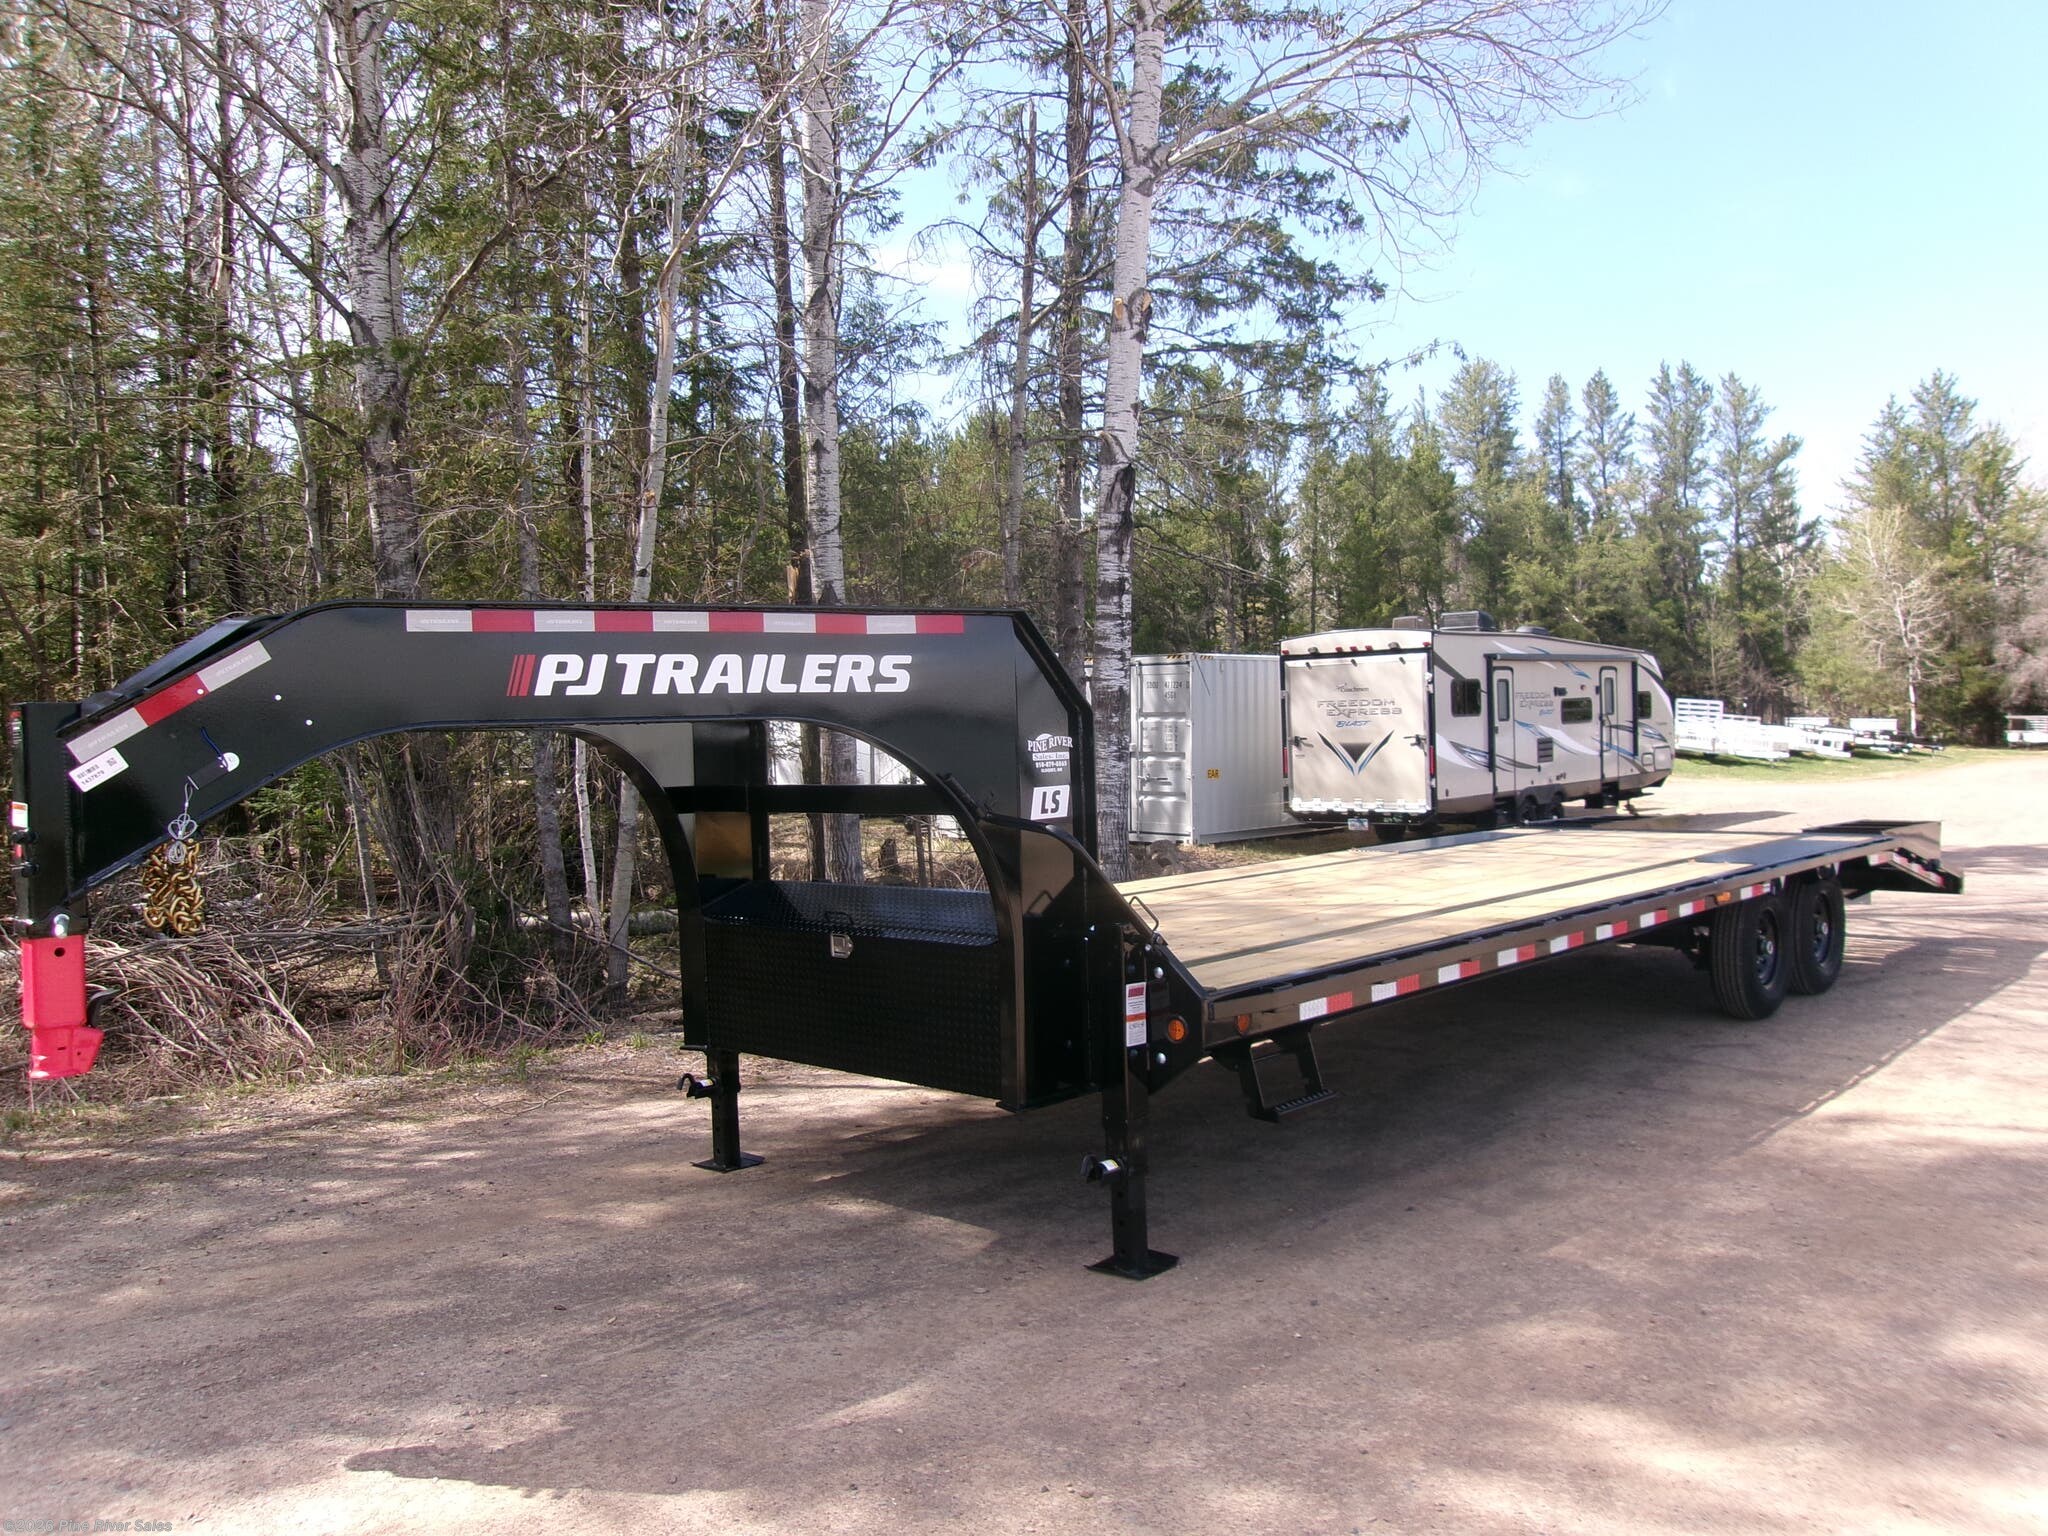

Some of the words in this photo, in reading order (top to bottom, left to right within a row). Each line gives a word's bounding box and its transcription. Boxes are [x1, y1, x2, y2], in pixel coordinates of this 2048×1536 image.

[534, 653, 609, 696] PJ
[615, 653, 913, 695] TRAILERS
[1317, 699, 1396, 708] FREEDOM
[1326, 707, 1402, 718] EXPRESS
[1027, 739, 1048, 752] PINE
[1048, 735, 1073, 749] RIVER
[1040, 789, 1061, 815] LS
